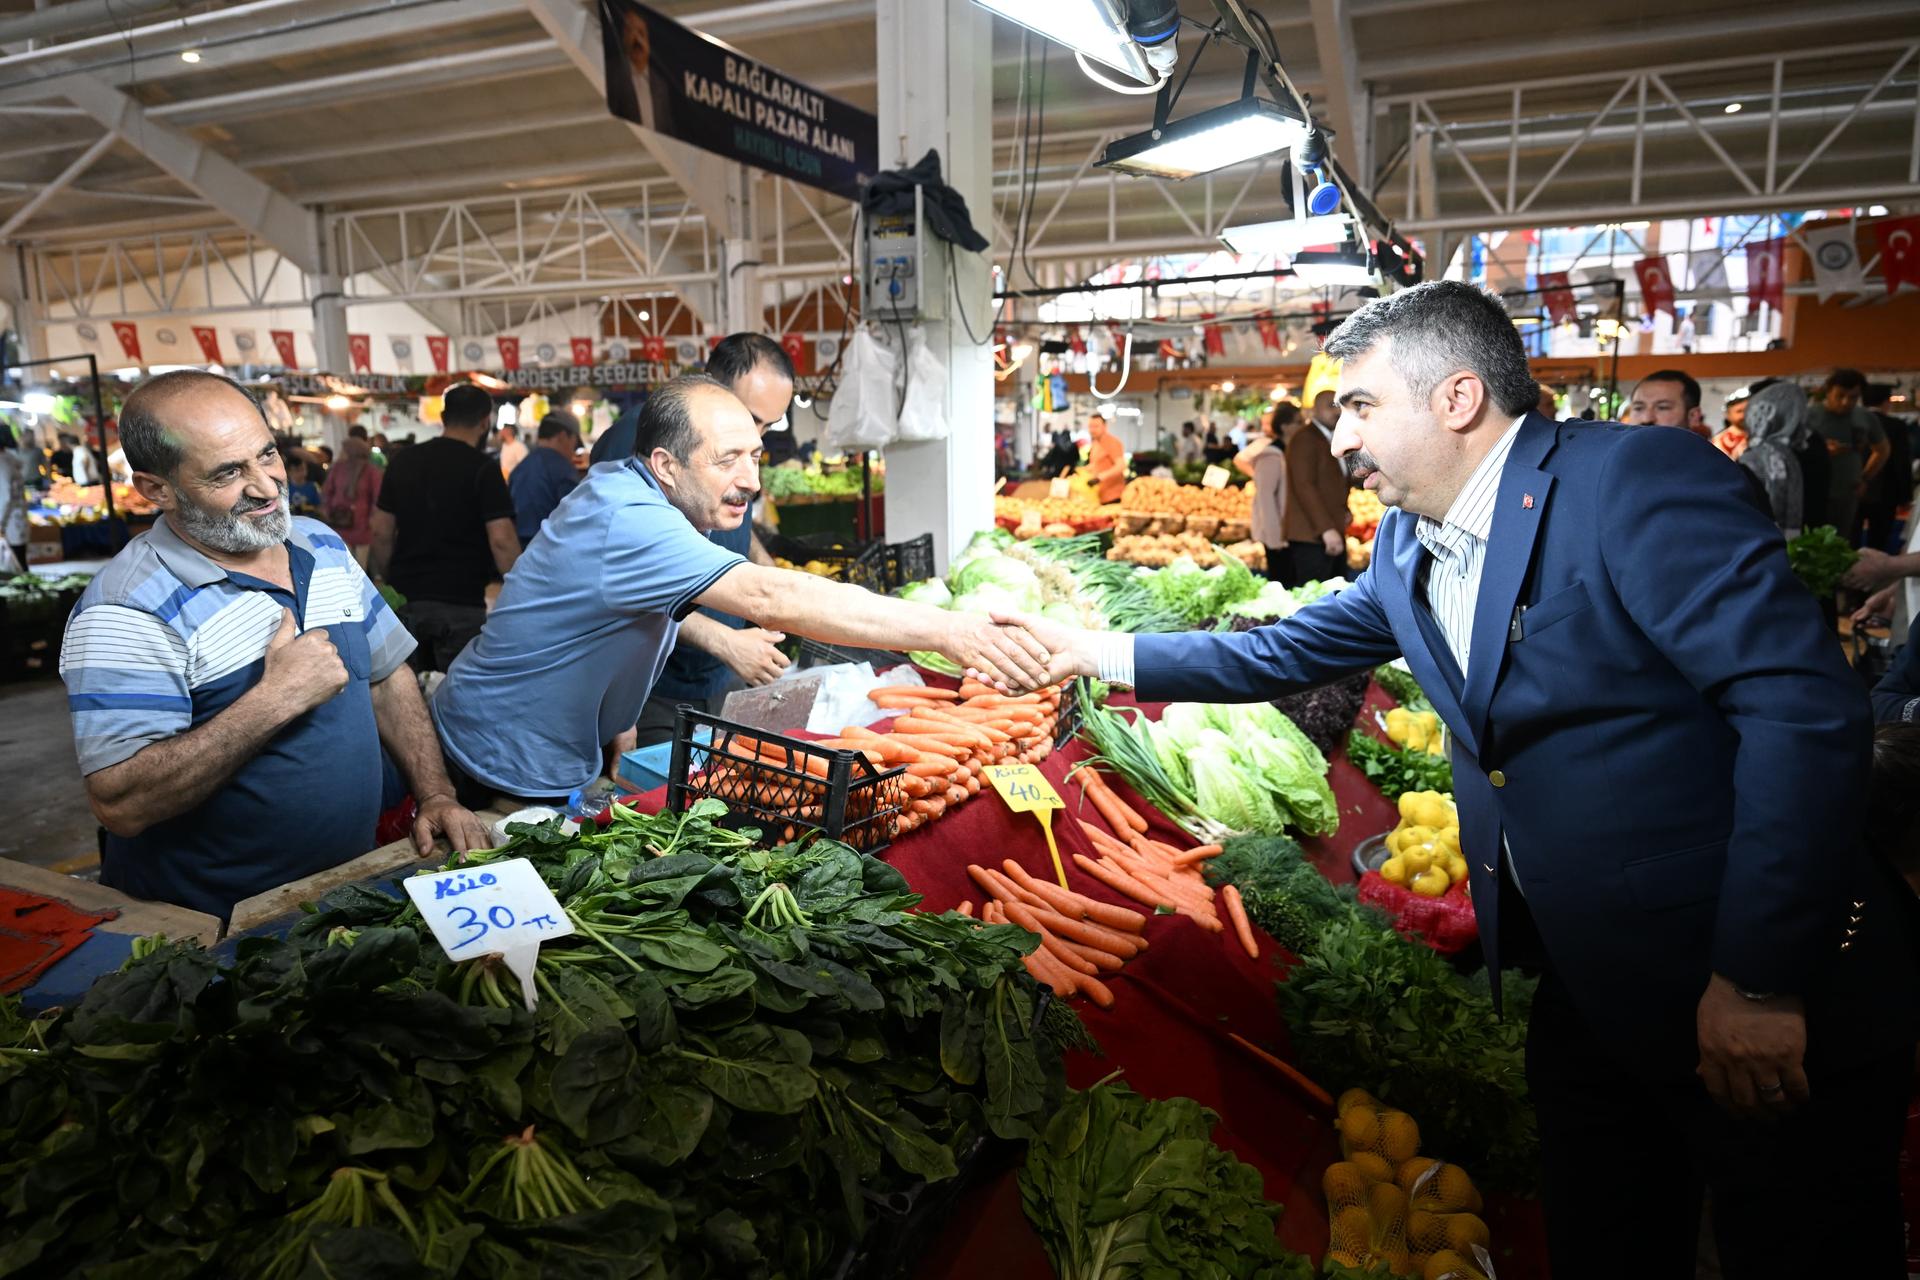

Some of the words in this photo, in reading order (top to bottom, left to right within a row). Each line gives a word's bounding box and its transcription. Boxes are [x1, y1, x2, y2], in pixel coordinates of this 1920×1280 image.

[684, 70, 751, 120] KAPALI
[755, 101, 809, 145] PAZAR
[812, 126, 856, 163] ALANI
[724, 56, 825, 123] BAĞLARALTI
